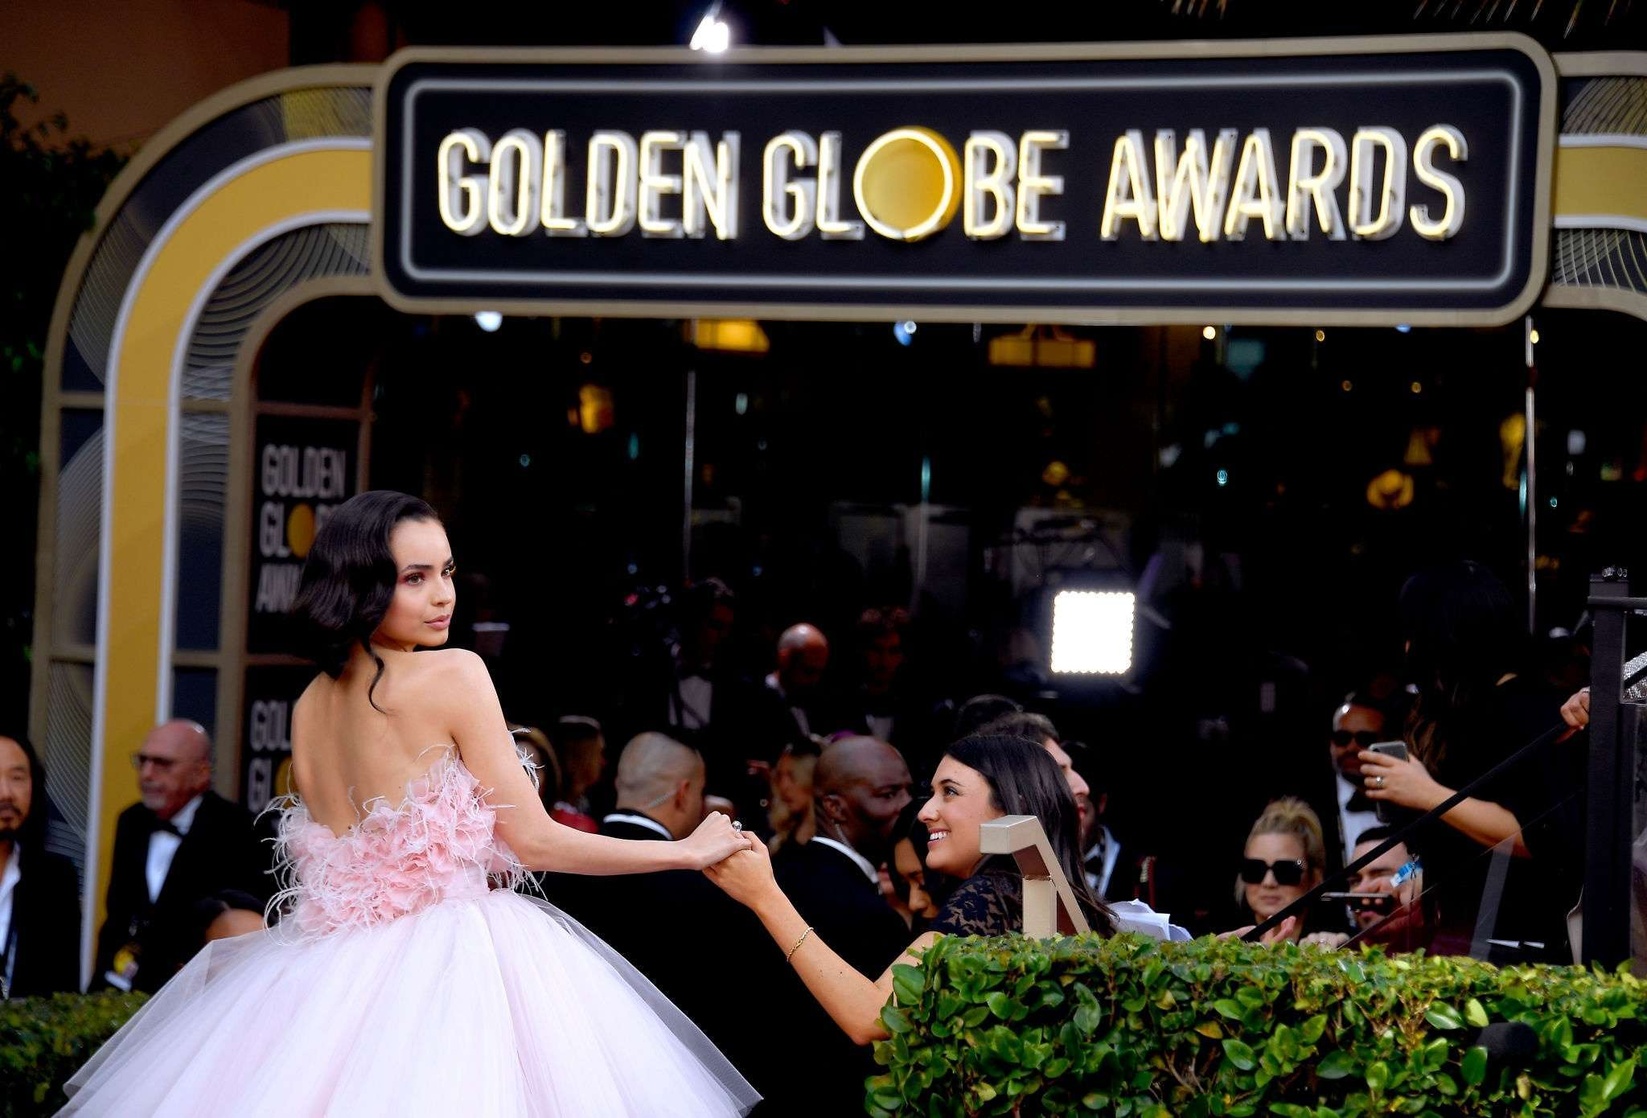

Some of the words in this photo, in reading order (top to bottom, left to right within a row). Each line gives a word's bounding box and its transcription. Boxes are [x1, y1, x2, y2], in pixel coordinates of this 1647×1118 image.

[437, 128, 741, 240] GOLDEN
[762, 126, 1069, 243] GLOBE
[1100, 125, 1468, 242] AWARDS
[261, 443, 346, 498] GOLDEN
[259, 501, 340, 559] GLO
[250, 700, 292, 751] GOL
